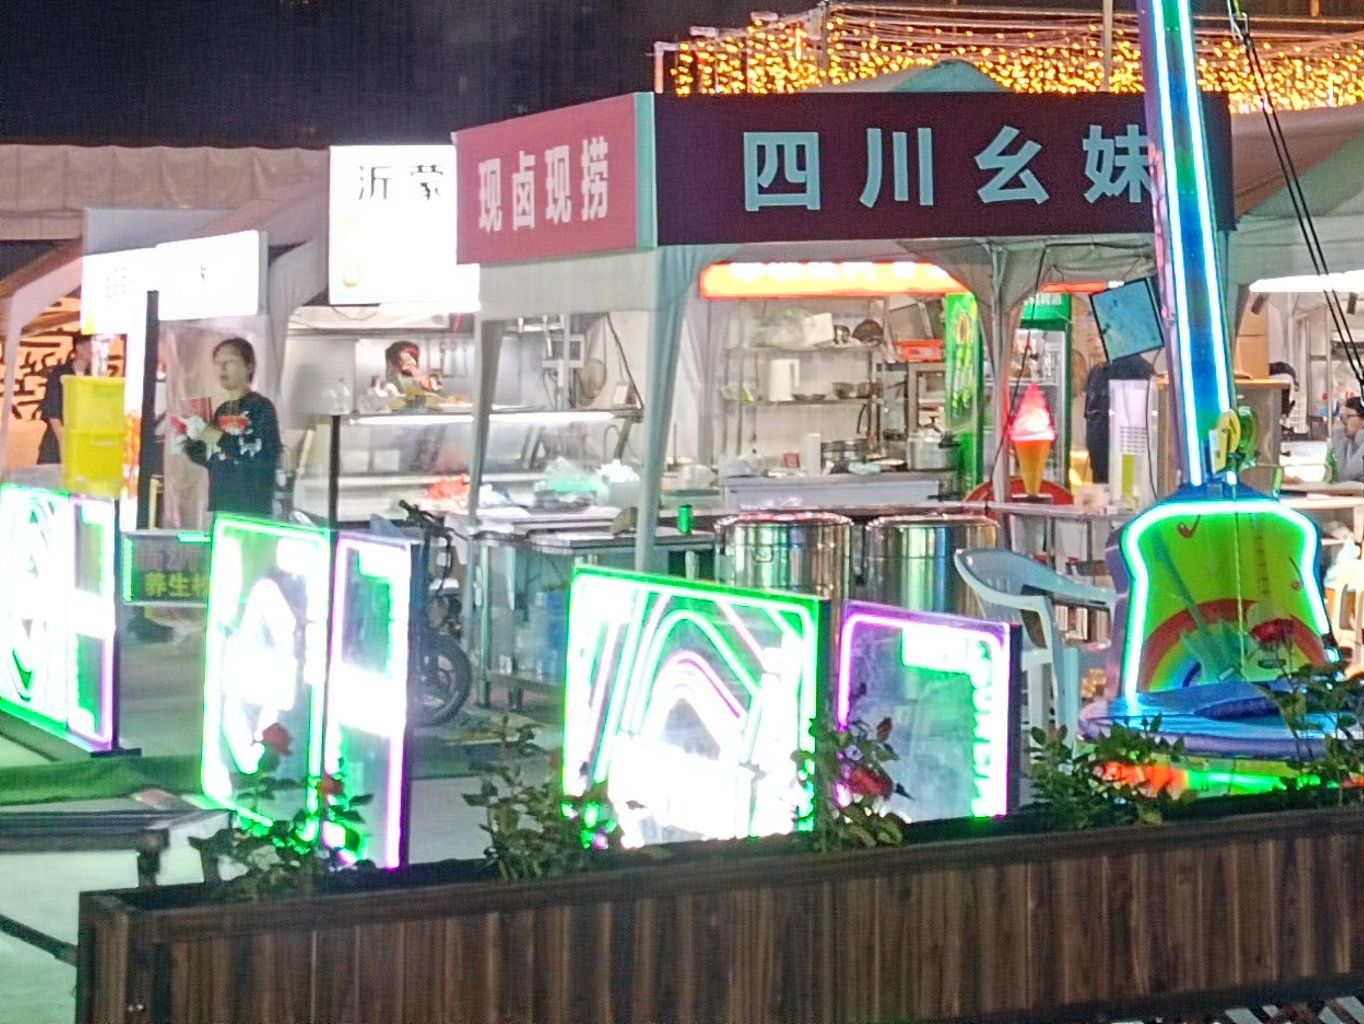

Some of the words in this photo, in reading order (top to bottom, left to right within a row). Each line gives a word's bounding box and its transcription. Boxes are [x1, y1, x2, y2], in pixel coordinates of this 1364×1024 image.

[477, 136, 609, 234] 现卤现捞
[743, 124, 1152, 212] 四川幺妹
